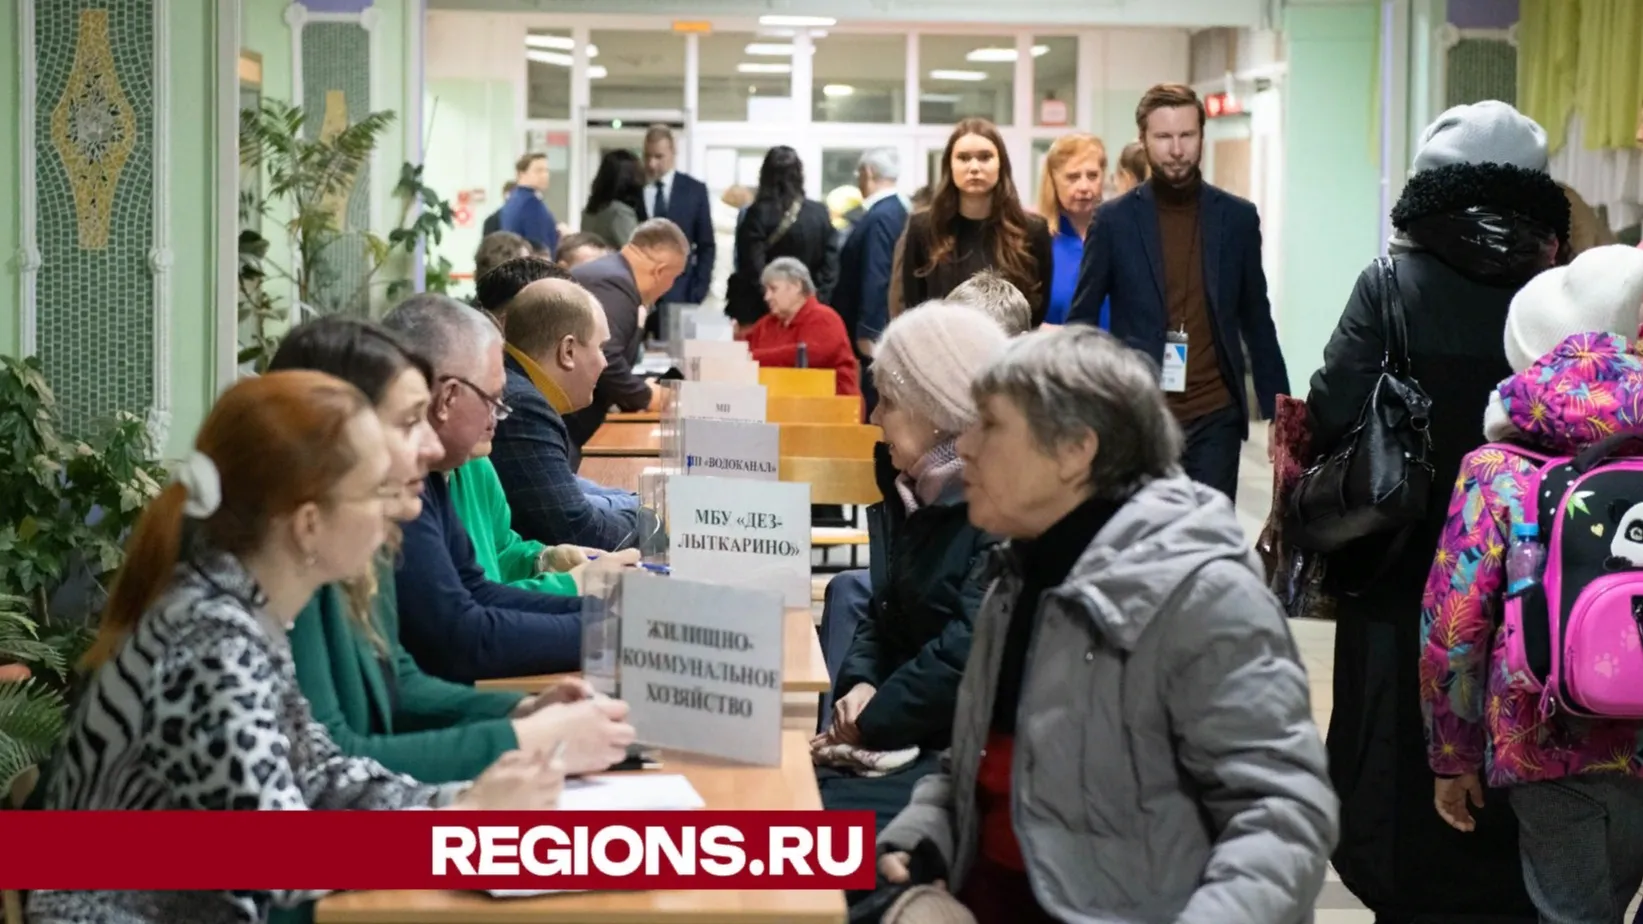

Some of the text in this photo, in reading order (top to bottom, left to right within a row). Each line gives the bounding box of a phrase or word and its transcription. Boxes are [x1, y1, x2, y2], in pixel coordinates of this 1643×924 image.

[704, 456, 777, 473] «ВОДОКАНАЛ»
[695, 508, 783, 530] МБУ «ДЕЗ-
[677, 533, 800, 557] ЛЫТКАРИНО»
[647, 619, 754, 652] ЖИЛИЩНО-
[623, 646, 780, 690] КОММУНАЛЬНОЕ
[645, 682, 753, 718] ХОЗЯЙСТВО
